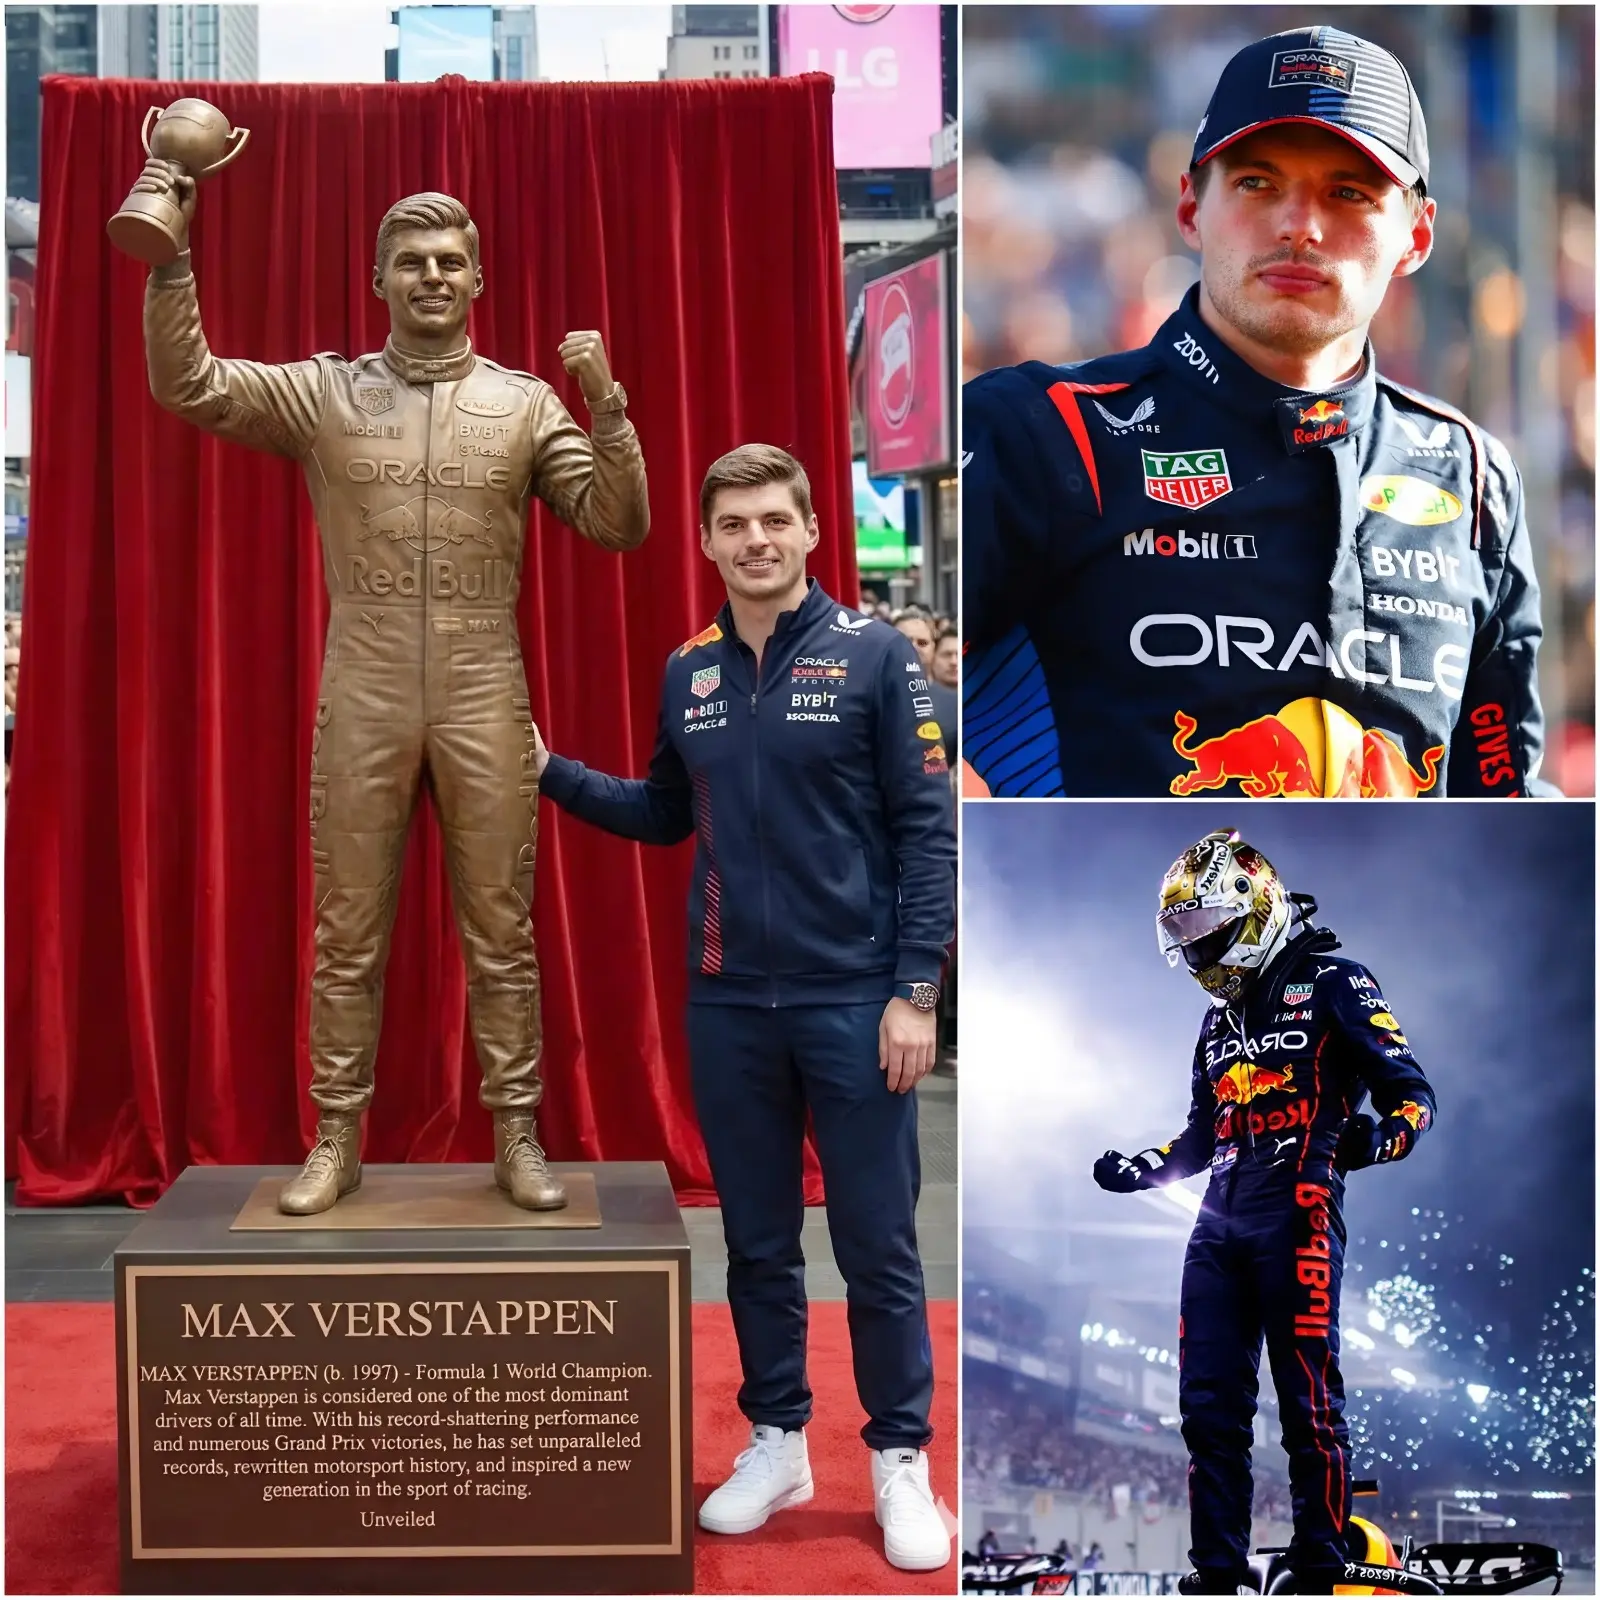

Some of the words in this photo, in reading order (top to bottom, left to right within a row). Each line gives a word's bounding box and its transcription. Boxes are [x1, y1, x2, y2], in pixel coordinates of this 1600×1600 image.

[1283, 53, 1349, 70] ORACLE
[346, 458, 511, 490] ORACLE
[1147, 454, 1219, 476] TAG
[1149, 478, 1225, 505] HEUER
[1123, 528, 1220, 560] Mobil
[348, 555, 422, 598] Red
[431, 559, 501, 600] Bull
[1371, 546, 1460, 587] BYBIT
[1368, 593, 1469, 626] HONDA
[1129, 613, 1469, 700] ORACLE
[791, 691, 838, 708] BYBIT
[1470, 703, 1516, 787] GIVES
[182, 1303, 295, 1338] MAX
[309, 1300, 618, 1338] VERSTAPPEN
[140, 1366, 187, 1382] MAX
[192, 1365, 318, 1382] VERSTAPPEN
[323, 1365, 345, 1384] (b.
[353, 1365, 399, 1384] 1997)
[415, 1364, 486, 1380] Formula
[492, 1363, 499, 1380] 1
[506, 1362, 557, 1379] World
[562, 1362, 652, 1382] Champion.
[165, 1389, 201, 1405] Max
[207, 1388, 299, 1408] Verstappen
[304, 1388, 317, 1404] is
[323, 1387, 412, 1404] considered
[418, 1391, 447, 1403] one
[453, 1387, 471, 1403] of
[475, 1387, 500, 1403] the
[505, 1388, 545, 1403] most
[551, 1386, 629, 1403] dominant
[155, 1413, 212, 1428] drivers
[218, 1412, 237, 1428] of
[240, 1412, 259, 1428] all
[265, 1412, 306, 1428] time.
[313, 1411, 353, 1427] With
[358, 1411, 382, 1427] his
[387, 1410, 529, 1430] record-shattering
[535, 1409, 639, 1430] performance
[154, 1435, 184, 1452] and
[189, 1439, 270, 1451] numerous
[275, 1434, 327, 1451] Grand
[332, 1434, 366, 1450] Prix
[371, 1433, 447, 1452] victories,
[453, 1433, 473, 1449] he
[478, 1433, 505, 1449] has
[510, 1434, 534, 1449] set
[539, 1432, 642, 1452] unparalleled
[163, 1458, 229, 1478] records,
[234, 1459, 309, 1475] rewritten
[314, 1459, 405, 1478] motorsport
[410, 1456, 470, 1477] history,
[475, 1456, 506, 1473] and
[511, 1456, 578, 1476] inspired
[583, 1460, 592, 1472] a
[597, 1459, 632, 1473] new
[262, 1481, 350, 1502] generation
[356, 1480, 371, 1497] in
[376, 1480, 402, 1497] the
[407, 1482, 448, 1501] sport
[453, 1480, 473, 1497] of
[476, 1480, 532, 1500] racing.
[360, 1510, 436, 1528] Unveiled
